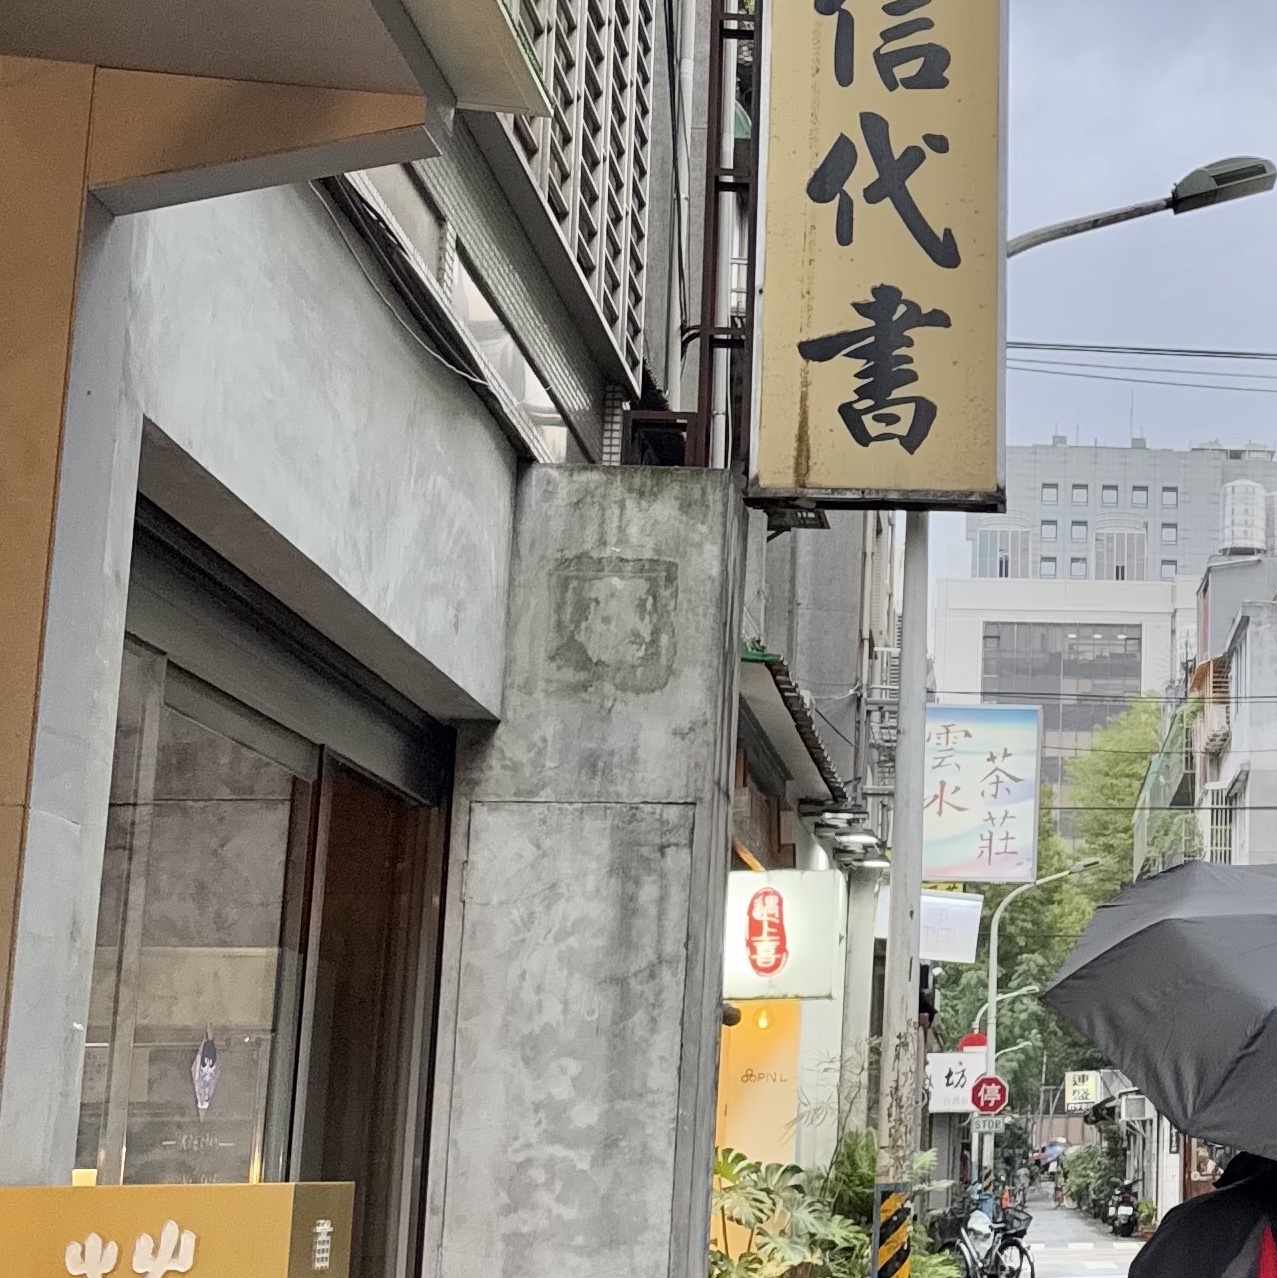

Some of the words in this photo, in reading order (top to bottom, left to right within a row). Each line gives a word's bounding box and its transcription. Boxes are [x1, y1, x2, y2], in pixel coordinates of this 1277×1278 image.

[924, 723, 972, 818] 雲水
[977, 747, 1025, 866] 茶莊
[974, 1118, 1001, 1130] STOP
[977, 1082, 1002, 1107] 停
